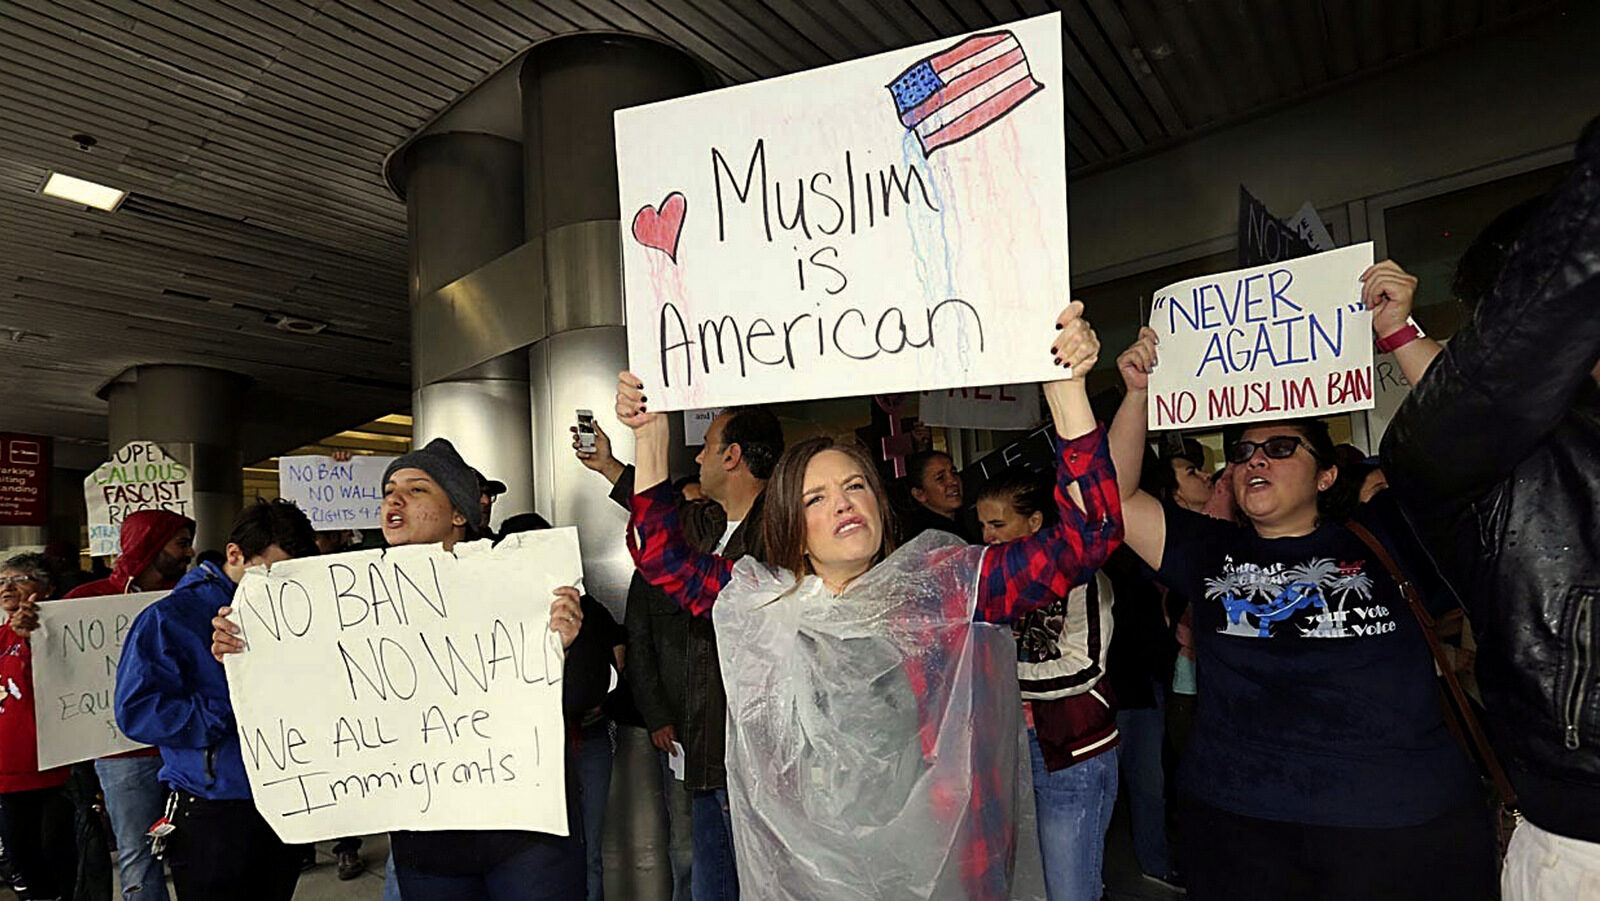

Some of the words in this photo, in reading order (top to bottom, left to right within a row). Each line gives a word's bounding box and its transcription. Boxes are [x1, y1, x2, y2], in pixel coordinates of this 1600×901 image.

[711, 138, 939, 242] Muslim
[793, 246, 848, 295] is
[660, 298, 985, 388] American
[1155, 390, 1197, 426] NO
[1208, 375, 1317, 421] MUSLIM
[1327, 366, 1373, 406] BAN
[0, 467, 36, 477] arking
[93, 463, 188, 485] CALLOUS
[289, 465, 313, 482] NO
[318, 463, 354, 481] BAN
[103, 480, 186, 504] FASCIST
[309, 485, 335, 502] NO
[340, 485, 384, 500] WALL
[312, 506, 356, 522] RIGHTS
[359, 507, 369, 519] 4
[237, 579, 312, 652] NO
[329, 556, 448, 632] BAN
[1352, 605, 1390, 621] Vote
[63, 619, 105, 657] NO
[1351, 621, 1397, 638] Voice
[337, 636, 418, 701] NO
[419, 618, 564, 696] WALL
[241, 718, 312, 771] We
[332, 716, 399, 758] ALL
[420, 704, 492, 744] Are
